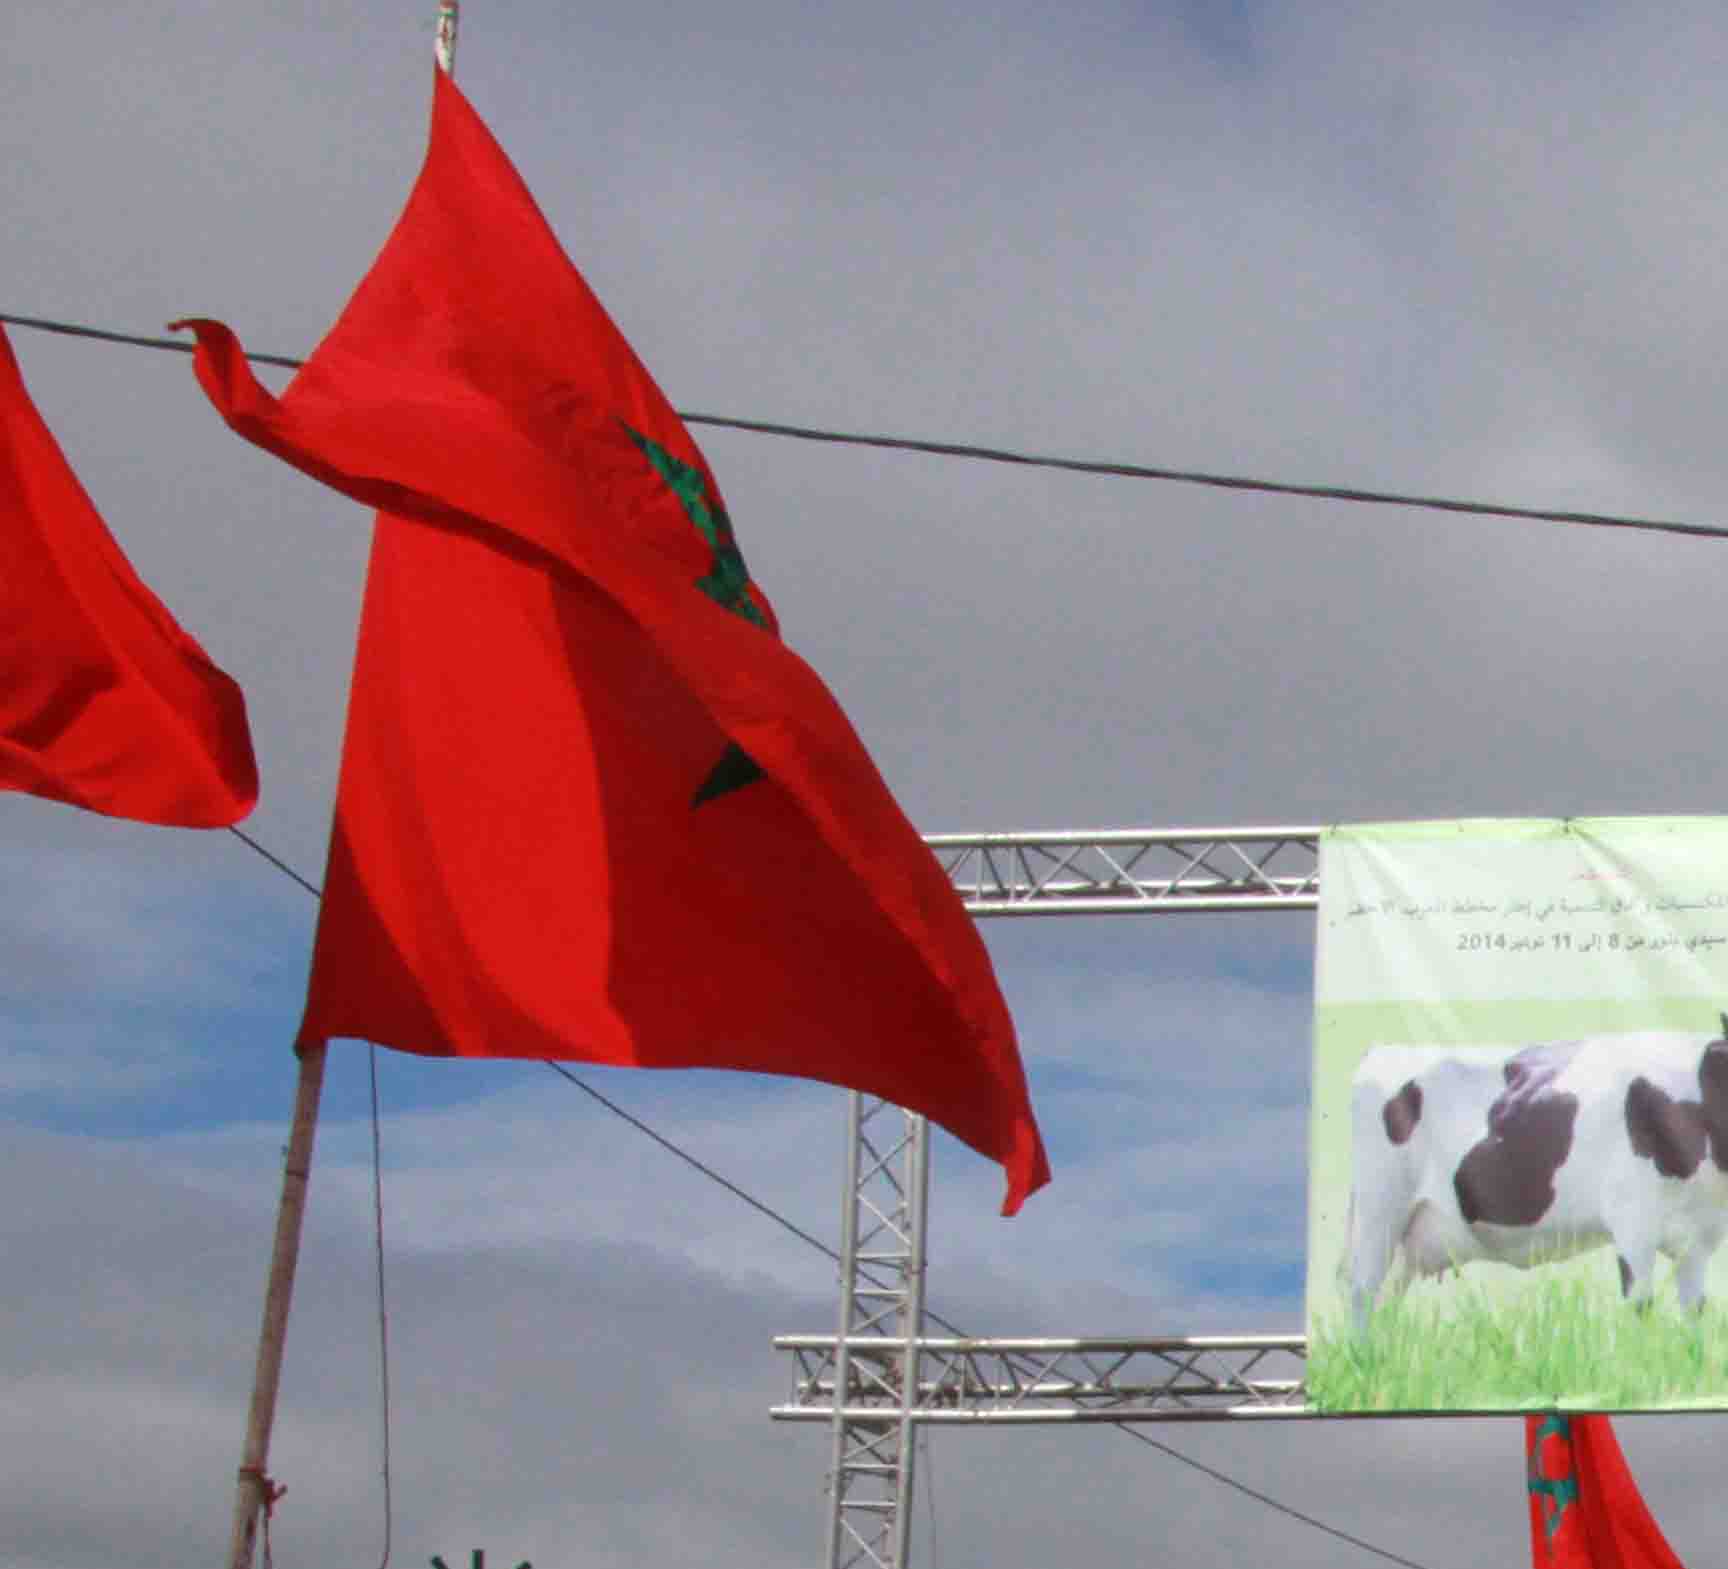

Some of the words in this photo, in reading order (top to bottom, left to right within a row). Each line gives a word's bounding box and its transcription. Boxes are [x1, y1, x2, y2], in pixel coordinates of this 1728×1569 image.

[1456, 933, 1508, 952] 2014
[1550, 932, 1572, 950] 11
[1607, 932, 1621, 949] 8
